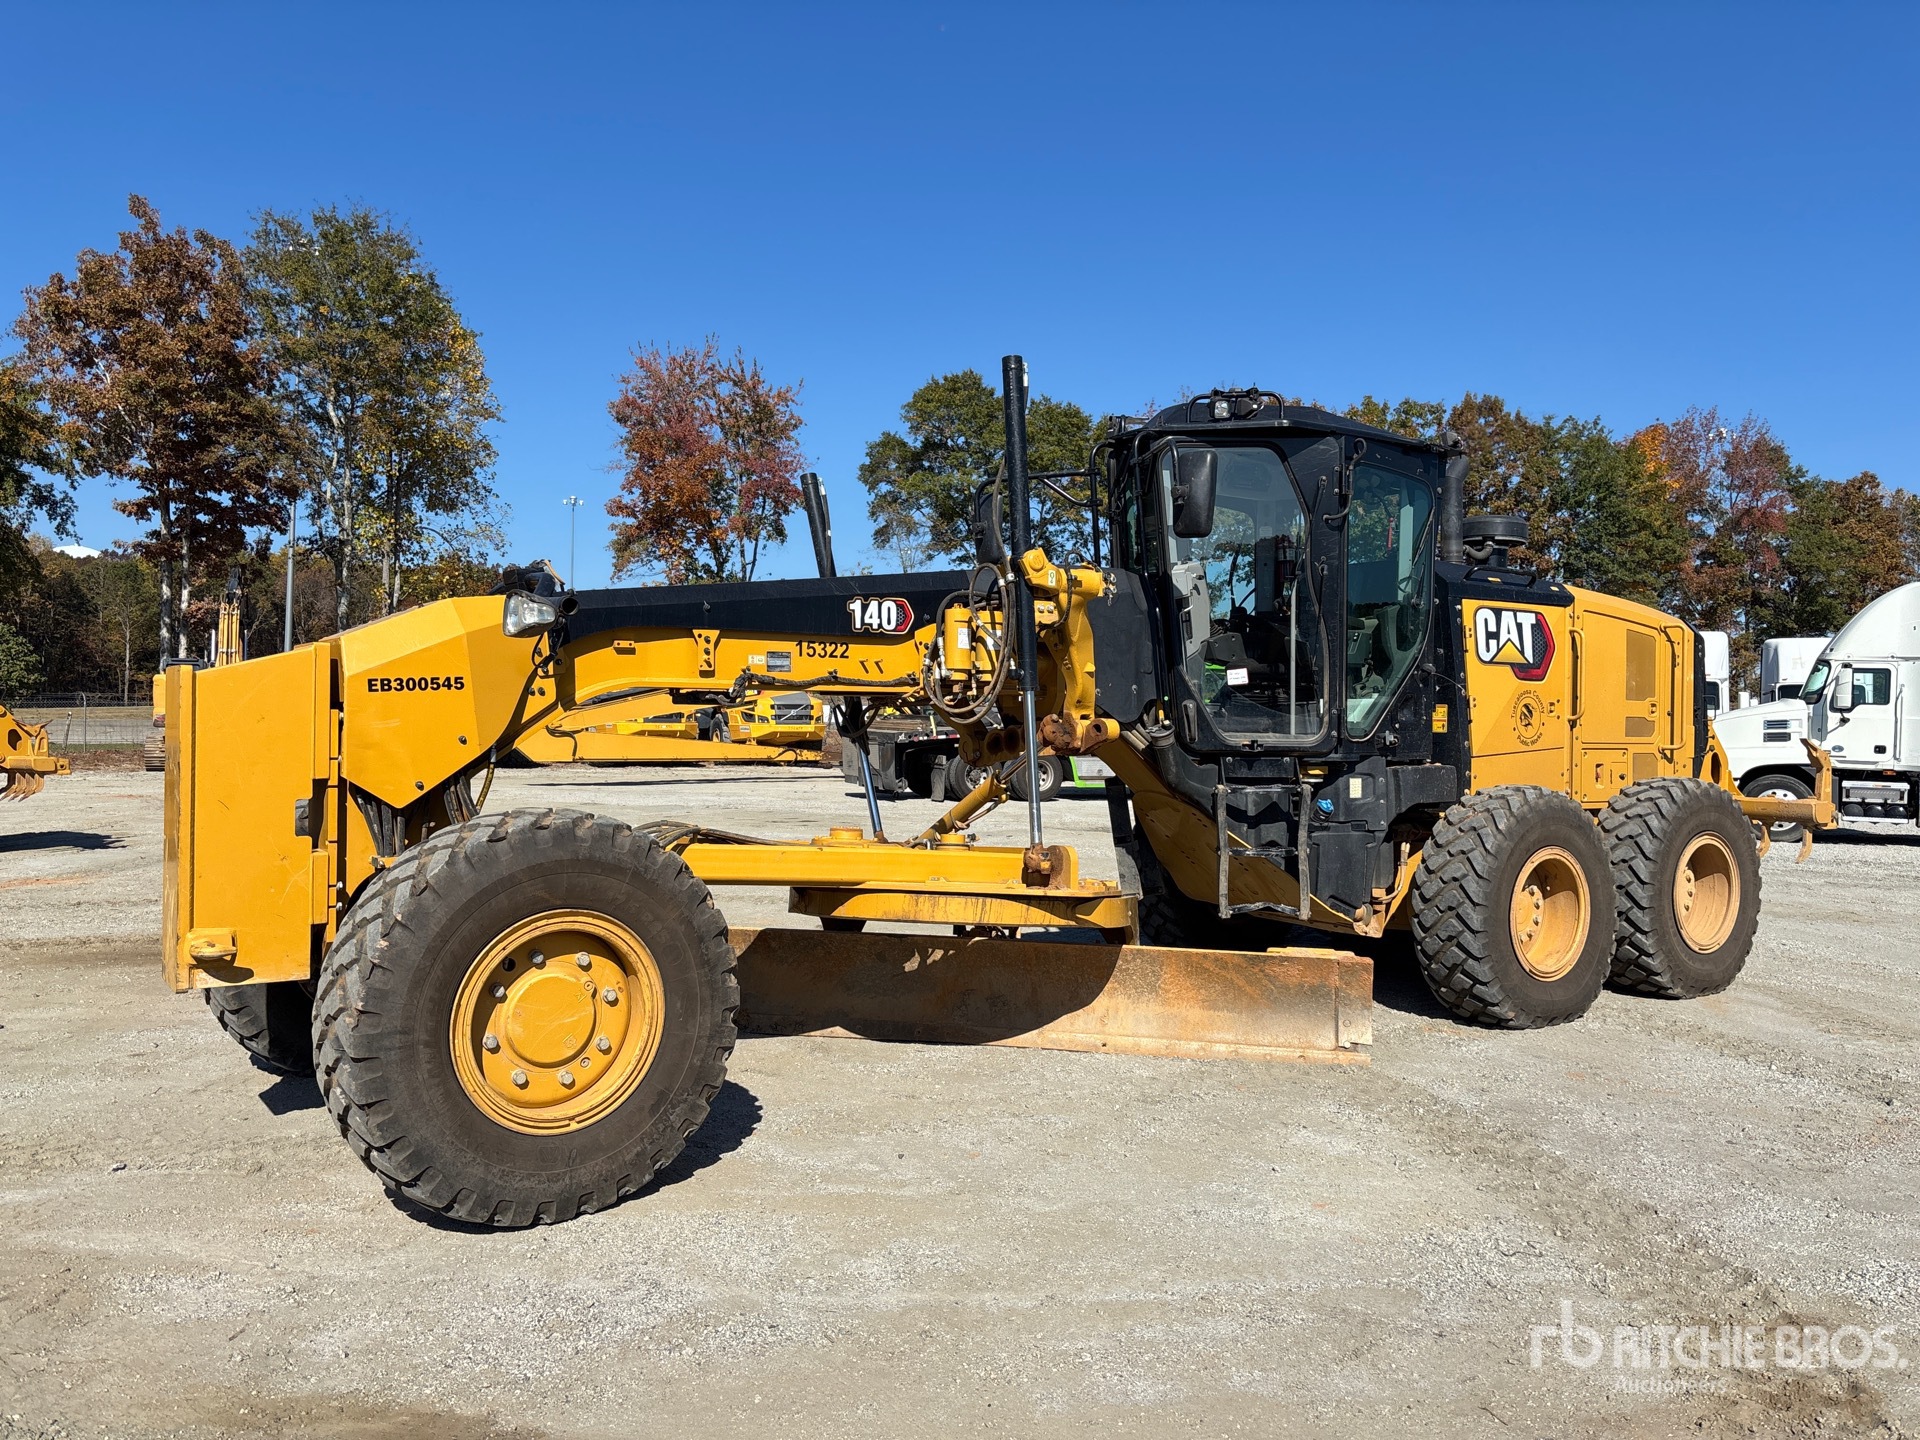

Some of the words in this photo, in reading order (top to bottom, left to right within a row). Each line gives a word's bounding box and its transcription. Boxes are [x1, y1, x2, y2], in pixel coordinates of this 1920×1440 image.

[849, 599, 898, 631] 140
[1475, 607, 1537, 664] CAT
[795, 639, 850, 659] 15322
[367, 676, 465, 693] EB300545
[1510, 689, 1532, 719] Tuscaloosa
[1532, 690, 1546, 714] County
[1516, 733, 1531, 747] Public
[1530, 731, 1543, 747] Works
